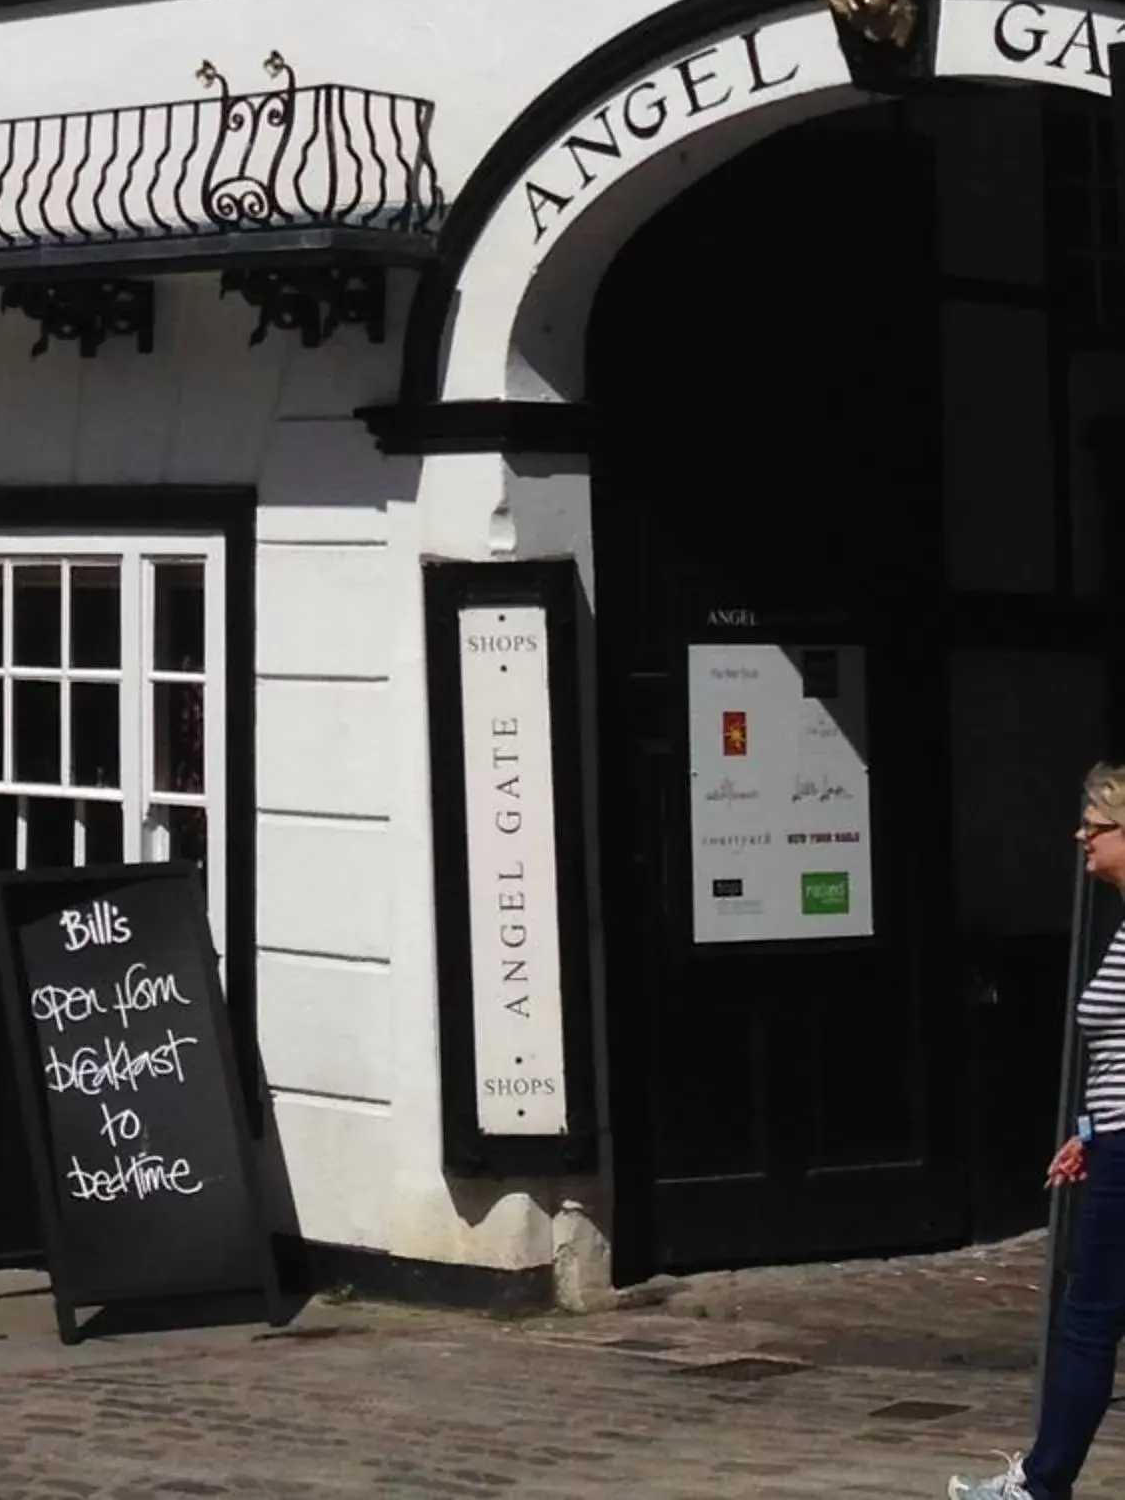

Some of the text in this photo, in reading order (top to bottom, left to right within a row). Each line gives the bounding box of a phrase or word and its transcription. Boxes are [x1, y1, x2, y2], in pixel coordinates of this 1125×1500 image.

[523, 27, 799, 245] ANGEL
[707, 609, 760, 627] ANGEL
[467, 633, 539, 653] SHOPS
[491, 716, 530, 1018] ANGEL GATE
[59, 900, 132, 951] Bill's
[31, 984, 107, 1031] open
[45, 1029, 198, 1095] breakfast
[483, 1076, 557, 1096] SHOPS
[99, 1101, 140, 1147] to
[67, 1154, 203, 1201] bedtime
